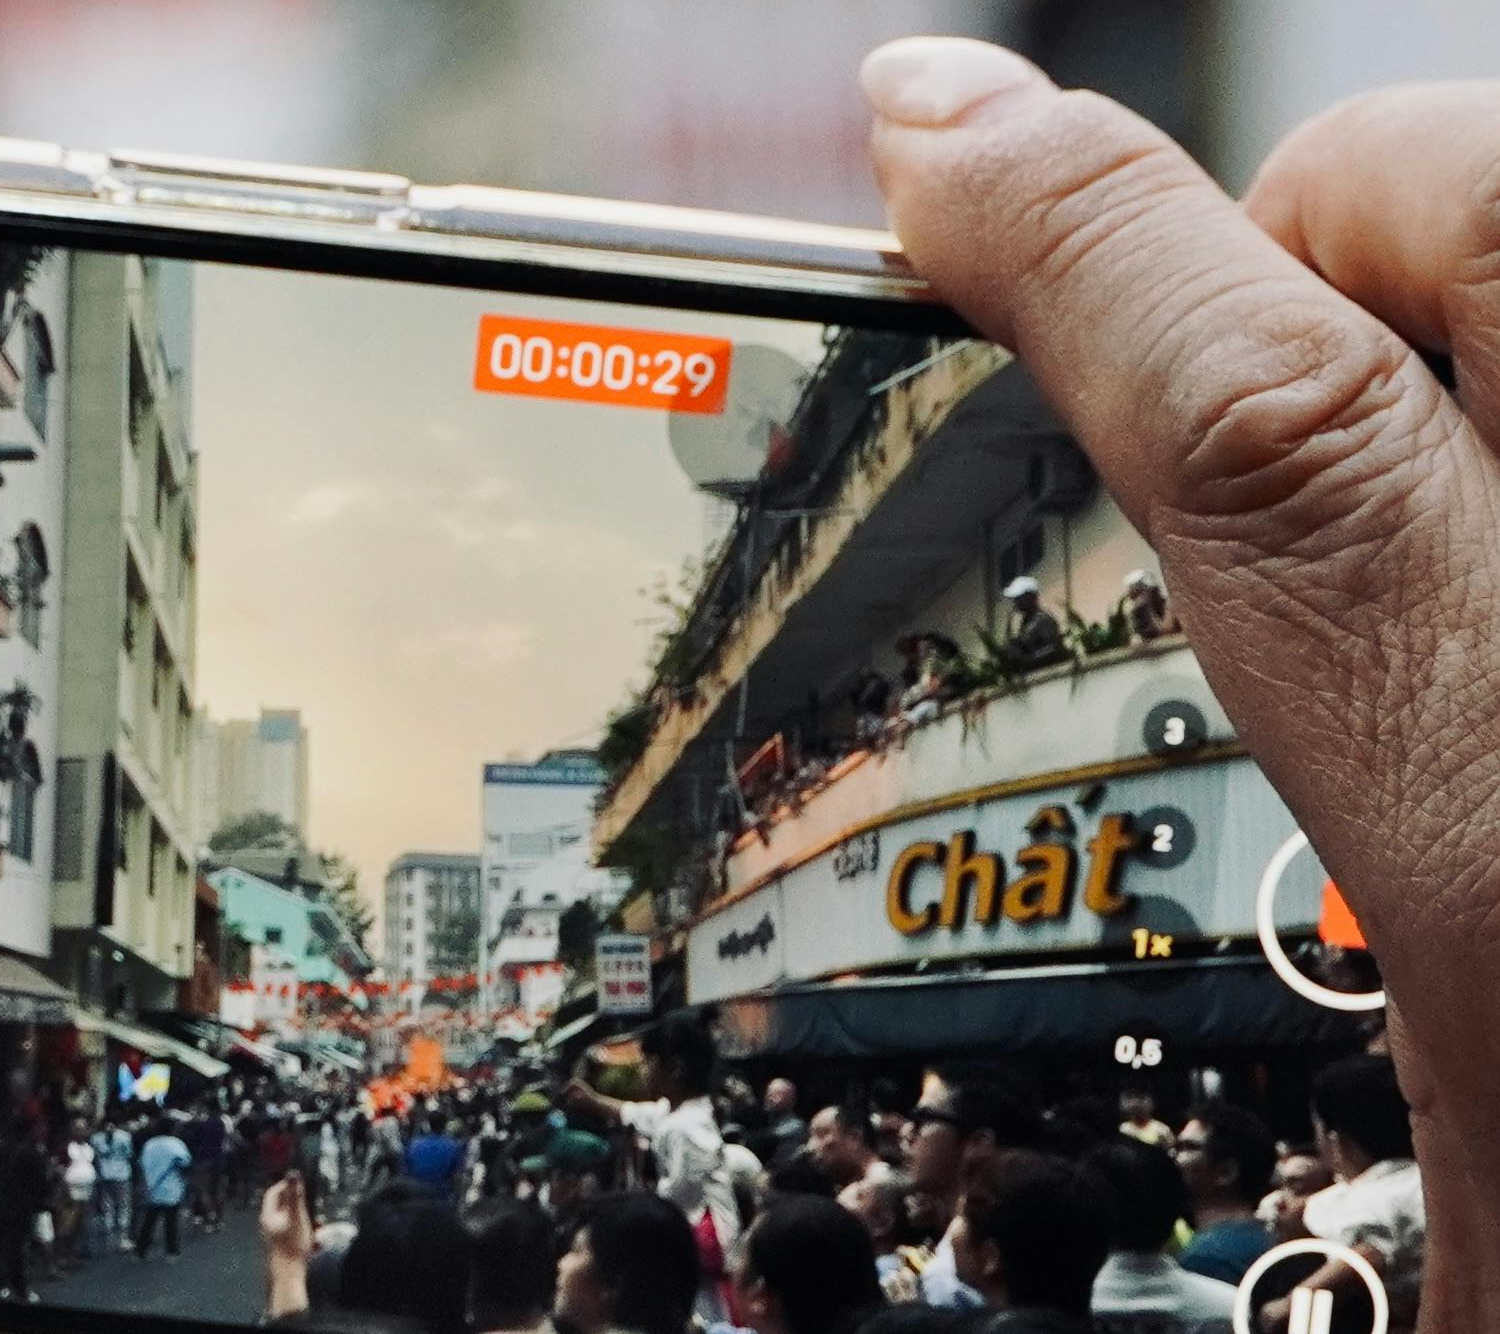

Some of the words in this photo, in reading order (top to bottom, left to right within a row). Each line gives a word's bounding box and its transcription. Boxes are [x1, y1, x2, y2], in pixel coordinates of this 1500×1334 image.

[490, 333, 716, 397] 00:00:29
[1163, 716, 1186, 746] 3
[1151, 823, 1174, 853] 2
[886, 783, 1136, 937] Chất
[1131, 927, 1174, 959] 1x
[1114, 1035, 1163, 1070] 0,5
